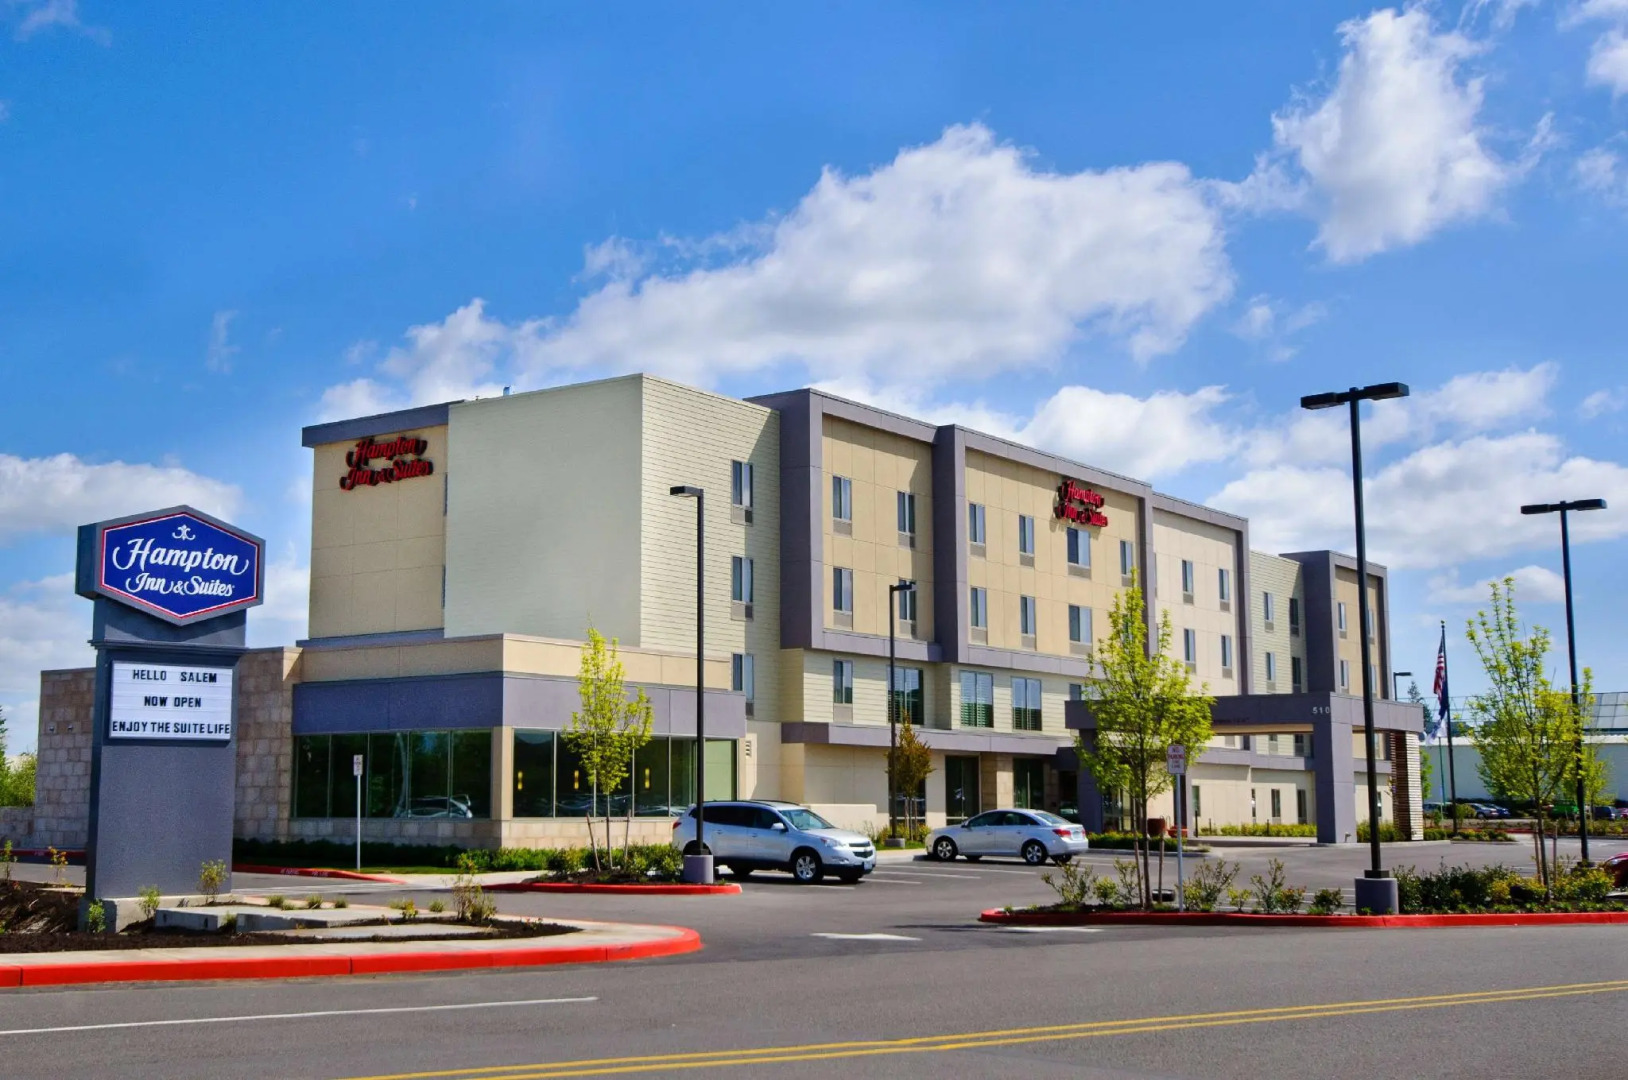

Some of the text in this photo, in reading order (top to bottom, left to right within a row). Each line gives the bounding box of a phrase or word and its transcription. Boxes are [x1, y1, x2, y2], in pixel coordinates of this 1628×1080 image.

[346, 436, 428, 469] Hampton
[392, 459, 434, 482] Suites
[112, 537, 249, 576] Hampton
[125, 572, 235, 597] Inn & Suites
[132, 669, 218, 683] HELLO SALEM
[144, 696, 202, 708] NOW OPEN
[1312, 706, 1330, 714] 510
[112, 721, 230, 735] ENJOY THE SUITE LIFE
